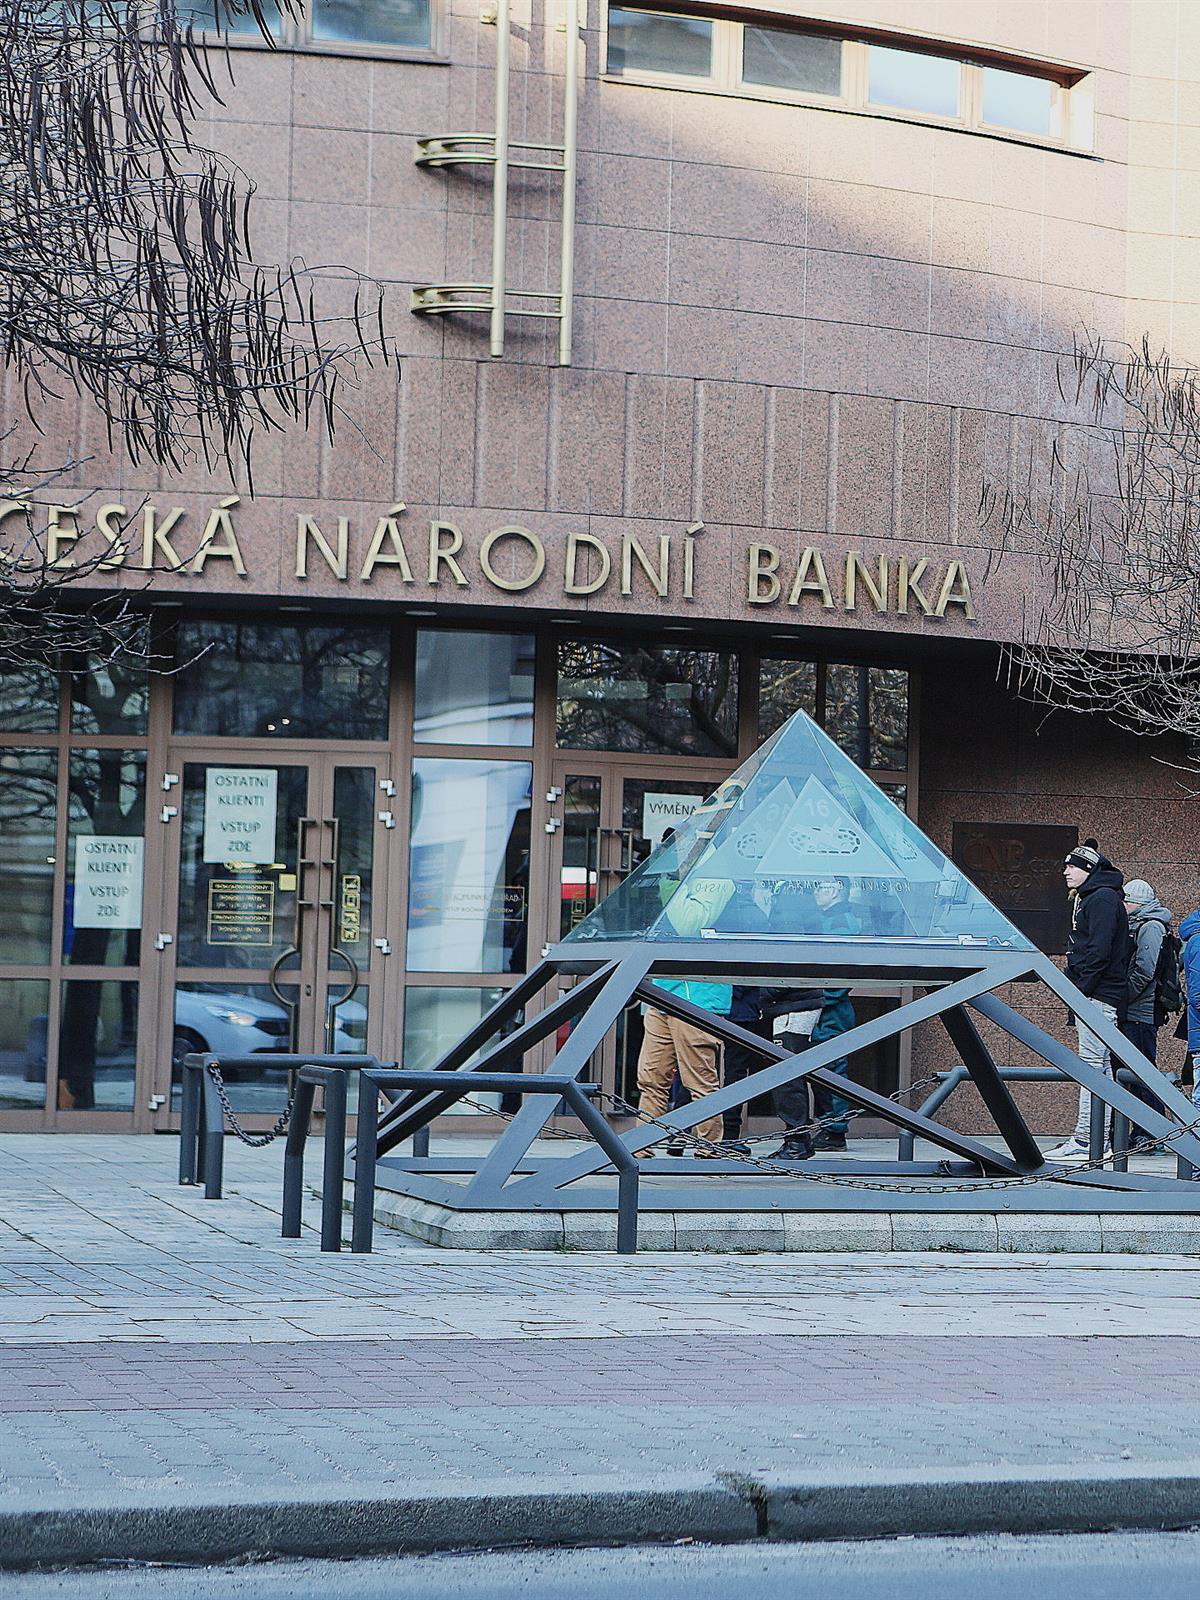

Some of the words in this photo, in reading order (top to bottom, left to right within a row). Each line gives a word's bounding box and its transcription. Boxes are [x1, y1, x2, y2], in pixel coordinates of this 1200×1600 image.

[295, 501, 705, 599] NÁRODNÍ
[747, 542, 977, 621] BANKA
[218, 793, 265, 806] KLIENTI
[649, 801, 697, 816] VÝMĚNA
[220, 820, 262, 834] VSTUP
[227, 840, 253, 852] ZDE
[87, 861, 132, 873] KLIENTI
[88, 885, 130, 898] VSTUP
[96, 904, 120, 917] ZDE
